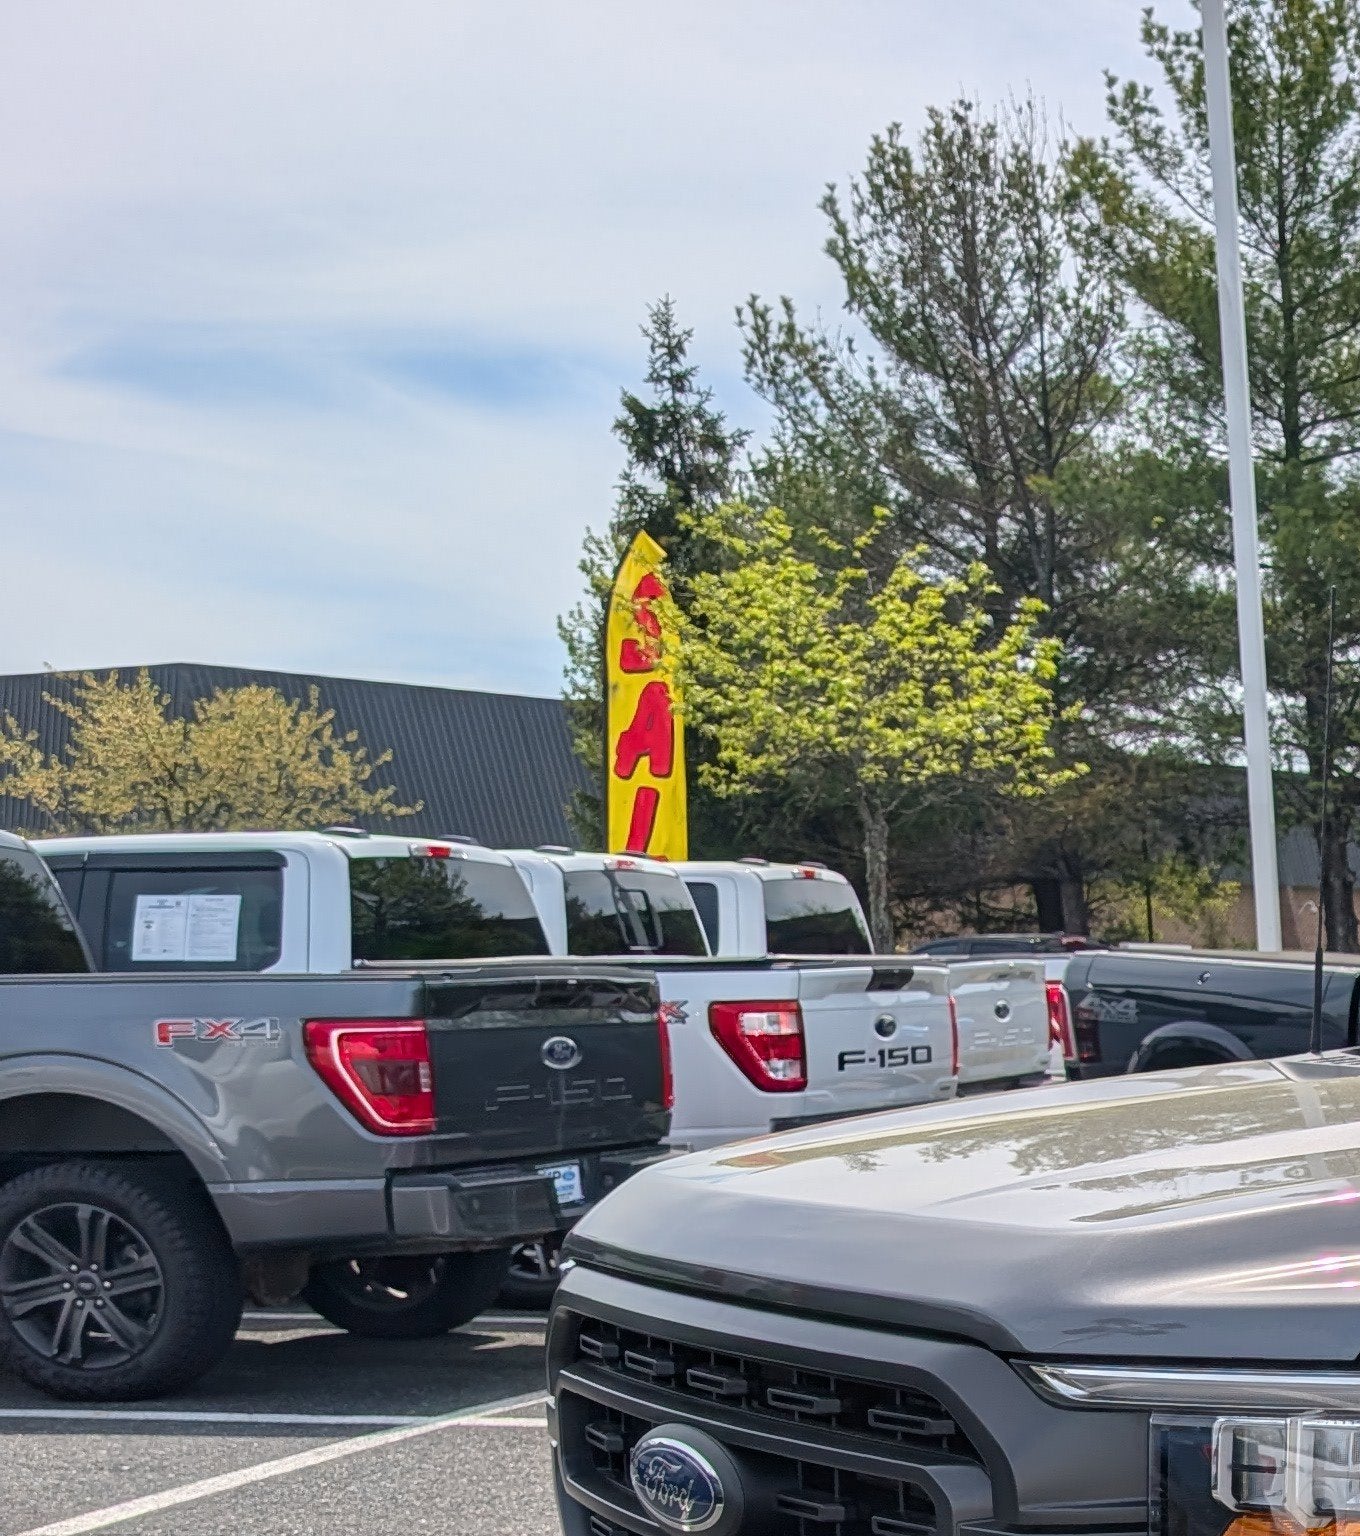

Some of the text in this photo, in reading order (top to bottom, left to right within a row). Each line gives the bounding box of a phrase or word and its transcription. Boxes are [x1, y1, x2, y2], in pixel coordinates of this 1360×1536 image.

[155, 1017, 281, 1048] FX4
[837, 1045, 932, 1072] F-150
[644, 1456, 695, 1513] Ford
